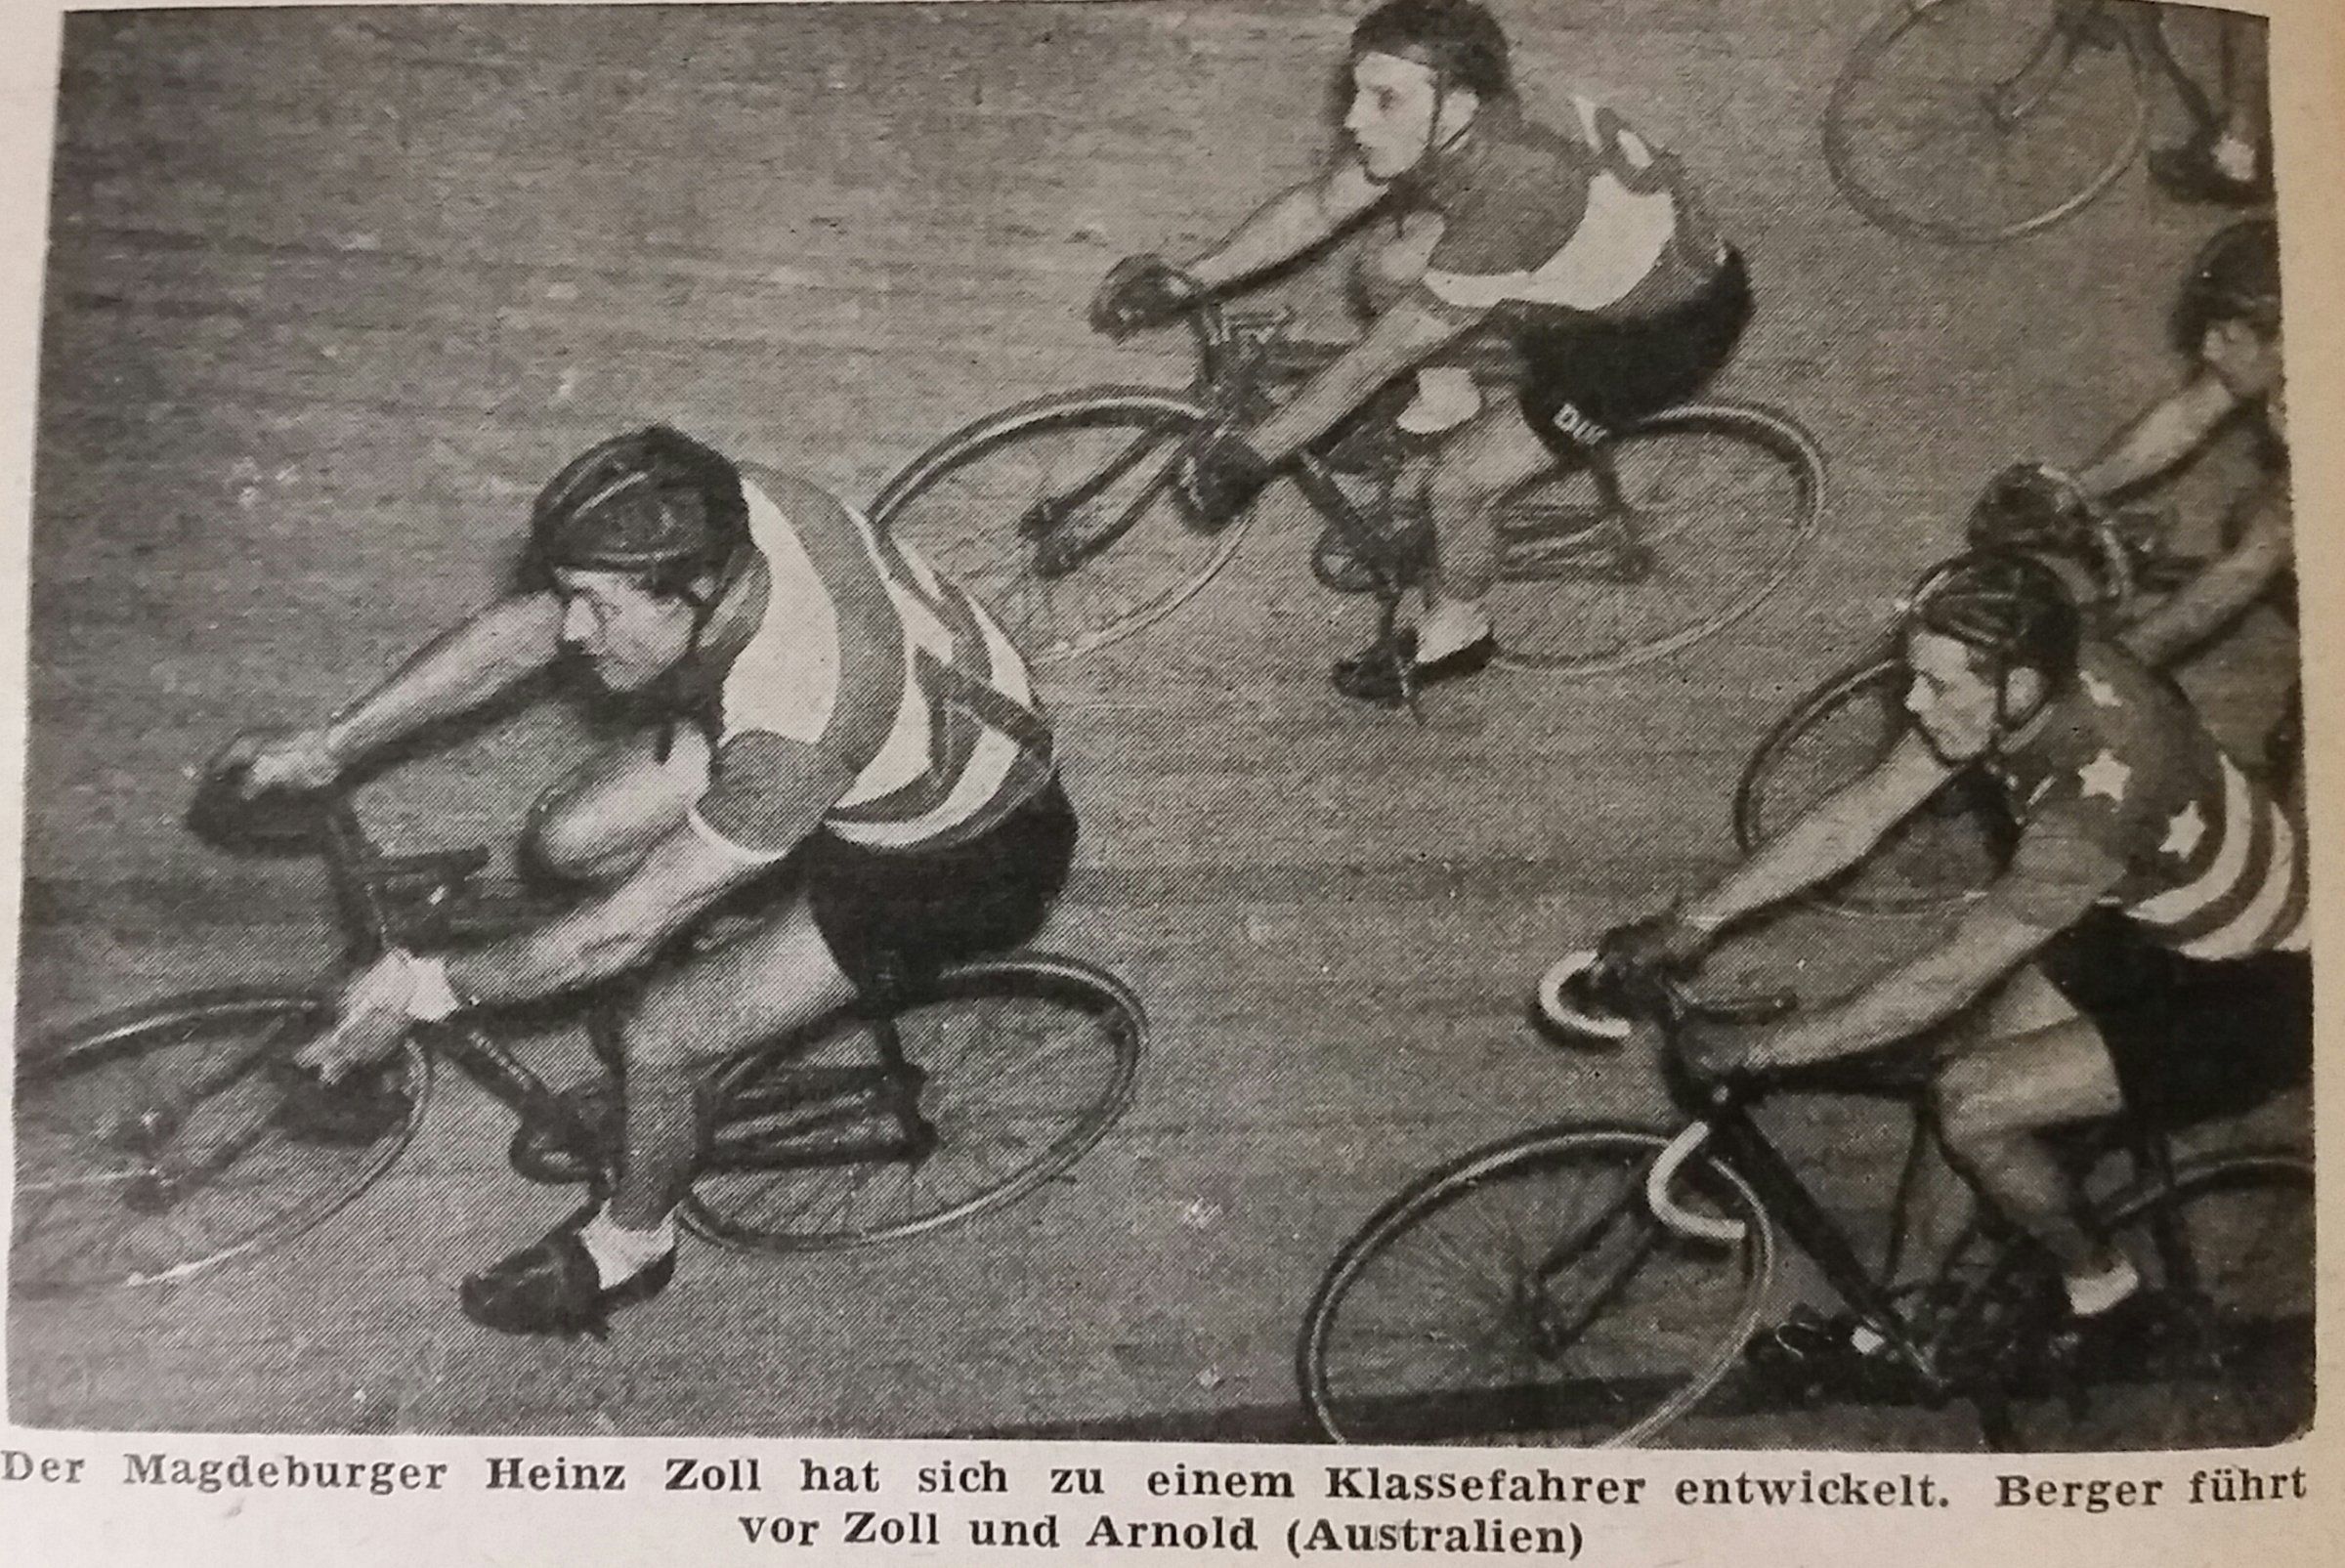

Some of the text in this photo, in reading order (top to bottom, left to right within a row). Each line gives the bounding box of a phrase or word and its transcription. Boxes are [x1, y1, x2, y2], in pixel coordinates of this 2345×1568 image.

[0, 1450, 2308, 1514] Der Magdeburger Heinz Zoll hat sich zu einem Klassefahrer entwickelt. Berger führt
[737, 1510, 1584, 1557] vor Zoll und Arnold (Australien)
